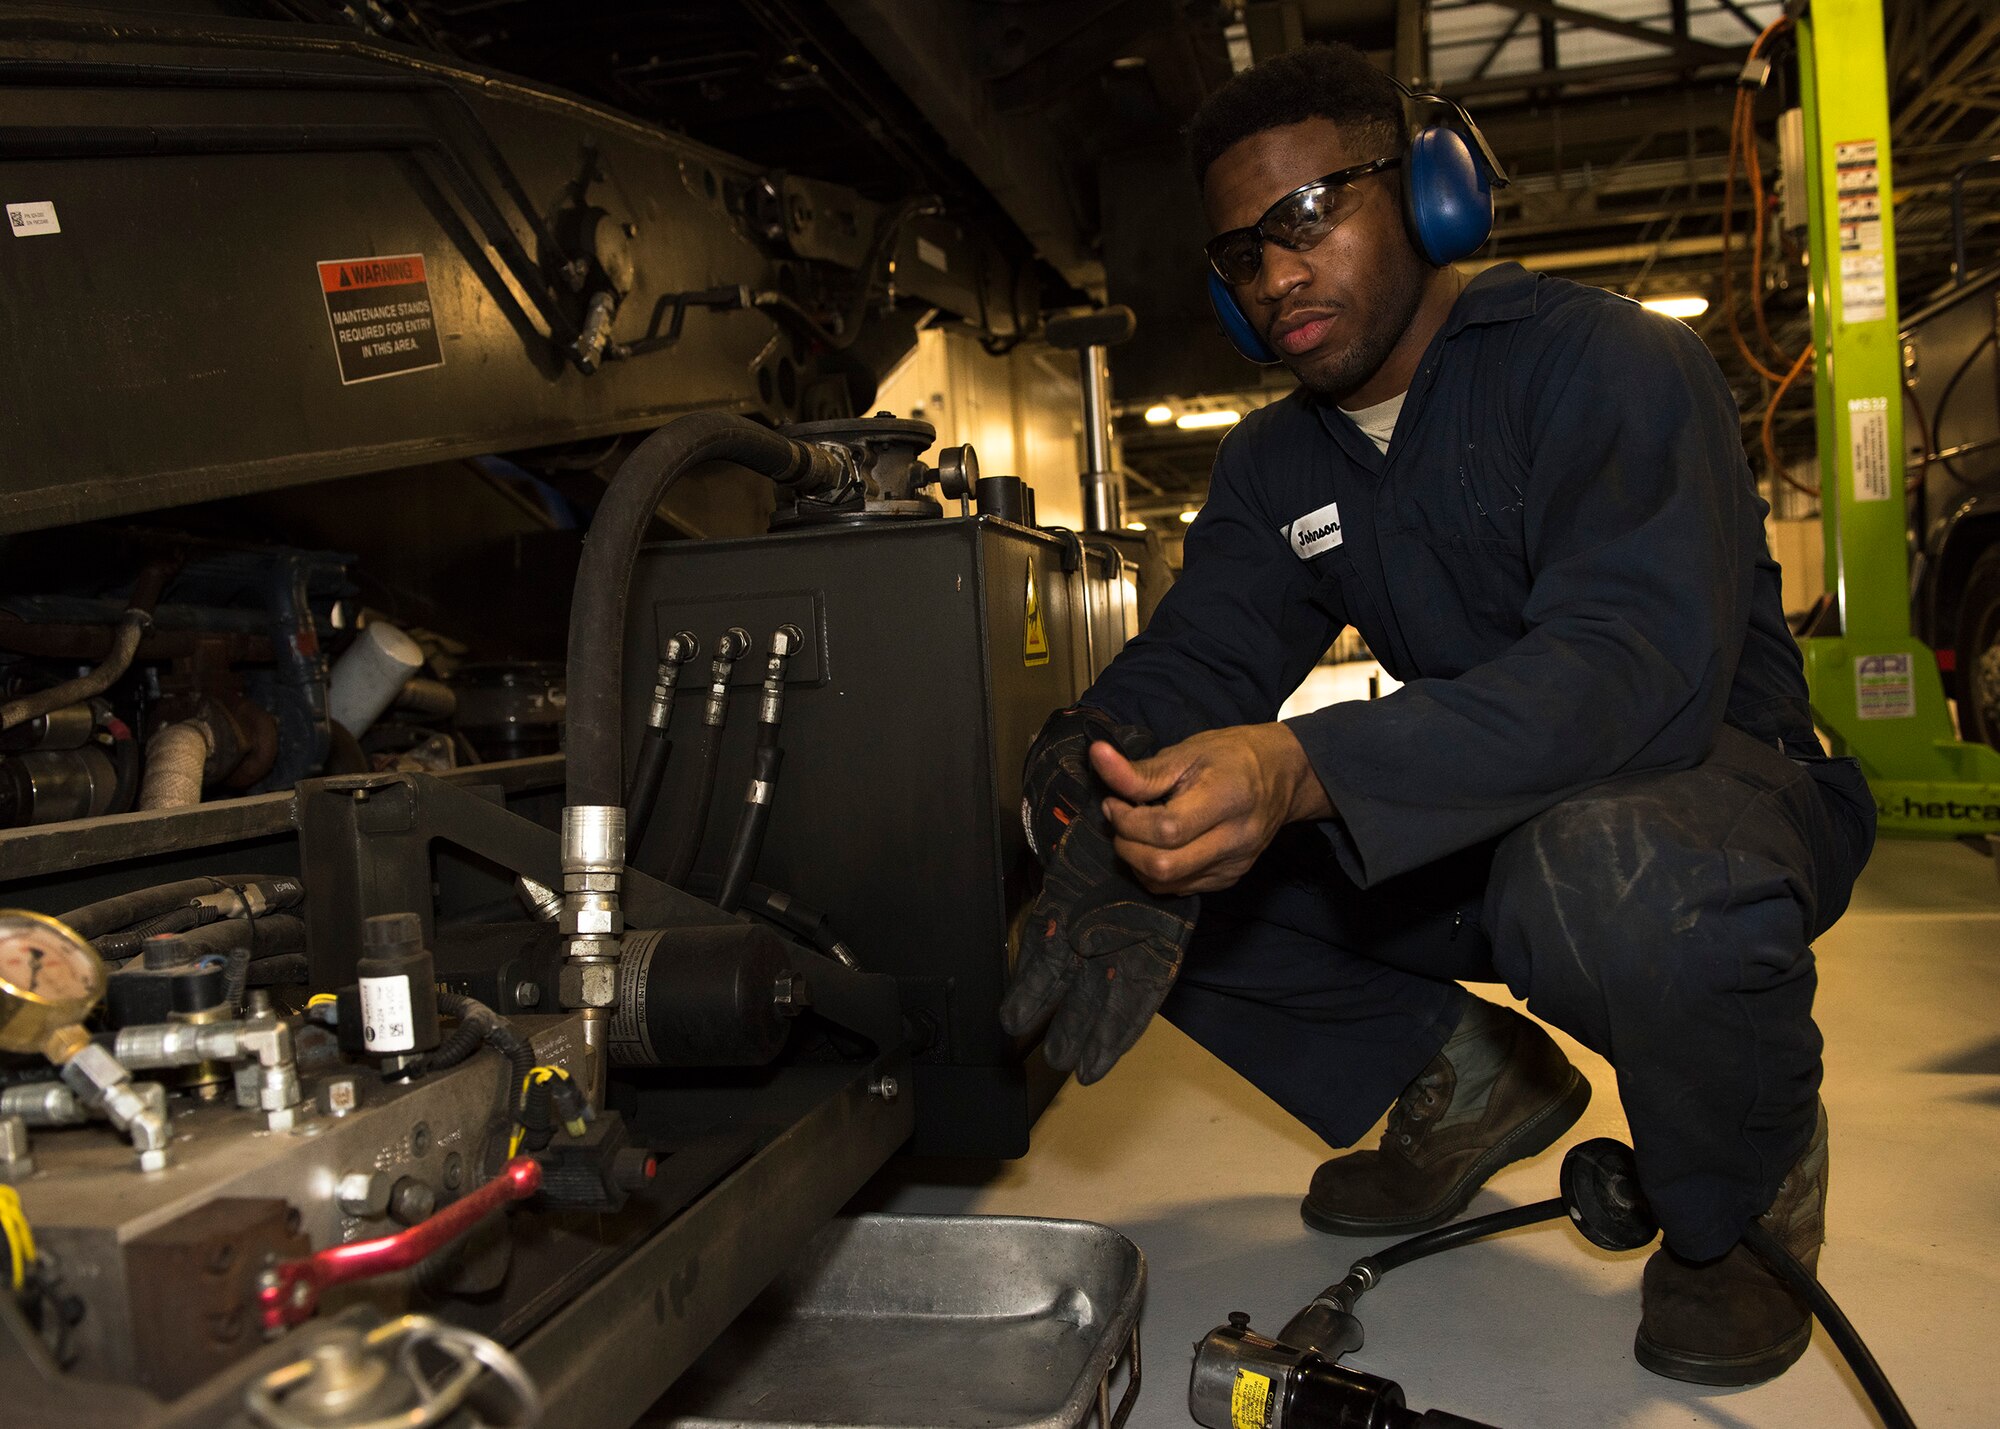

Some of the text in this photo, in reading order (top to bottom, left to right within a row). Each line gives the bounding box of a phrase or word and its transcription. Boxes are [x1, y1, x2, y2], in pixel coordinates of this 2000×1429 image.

[352, 262, 413, 284] WARNING
[333, 300, 430, 325] MAINTENANCE STANDS
[339, 318, 431, 343] REQUIRED FOR ENTRY
[361, 338, 419, 358] IN THIS AREA.
[1298, 522, 1341, 546] Johnson
[638, 990, 645, 999] IN
